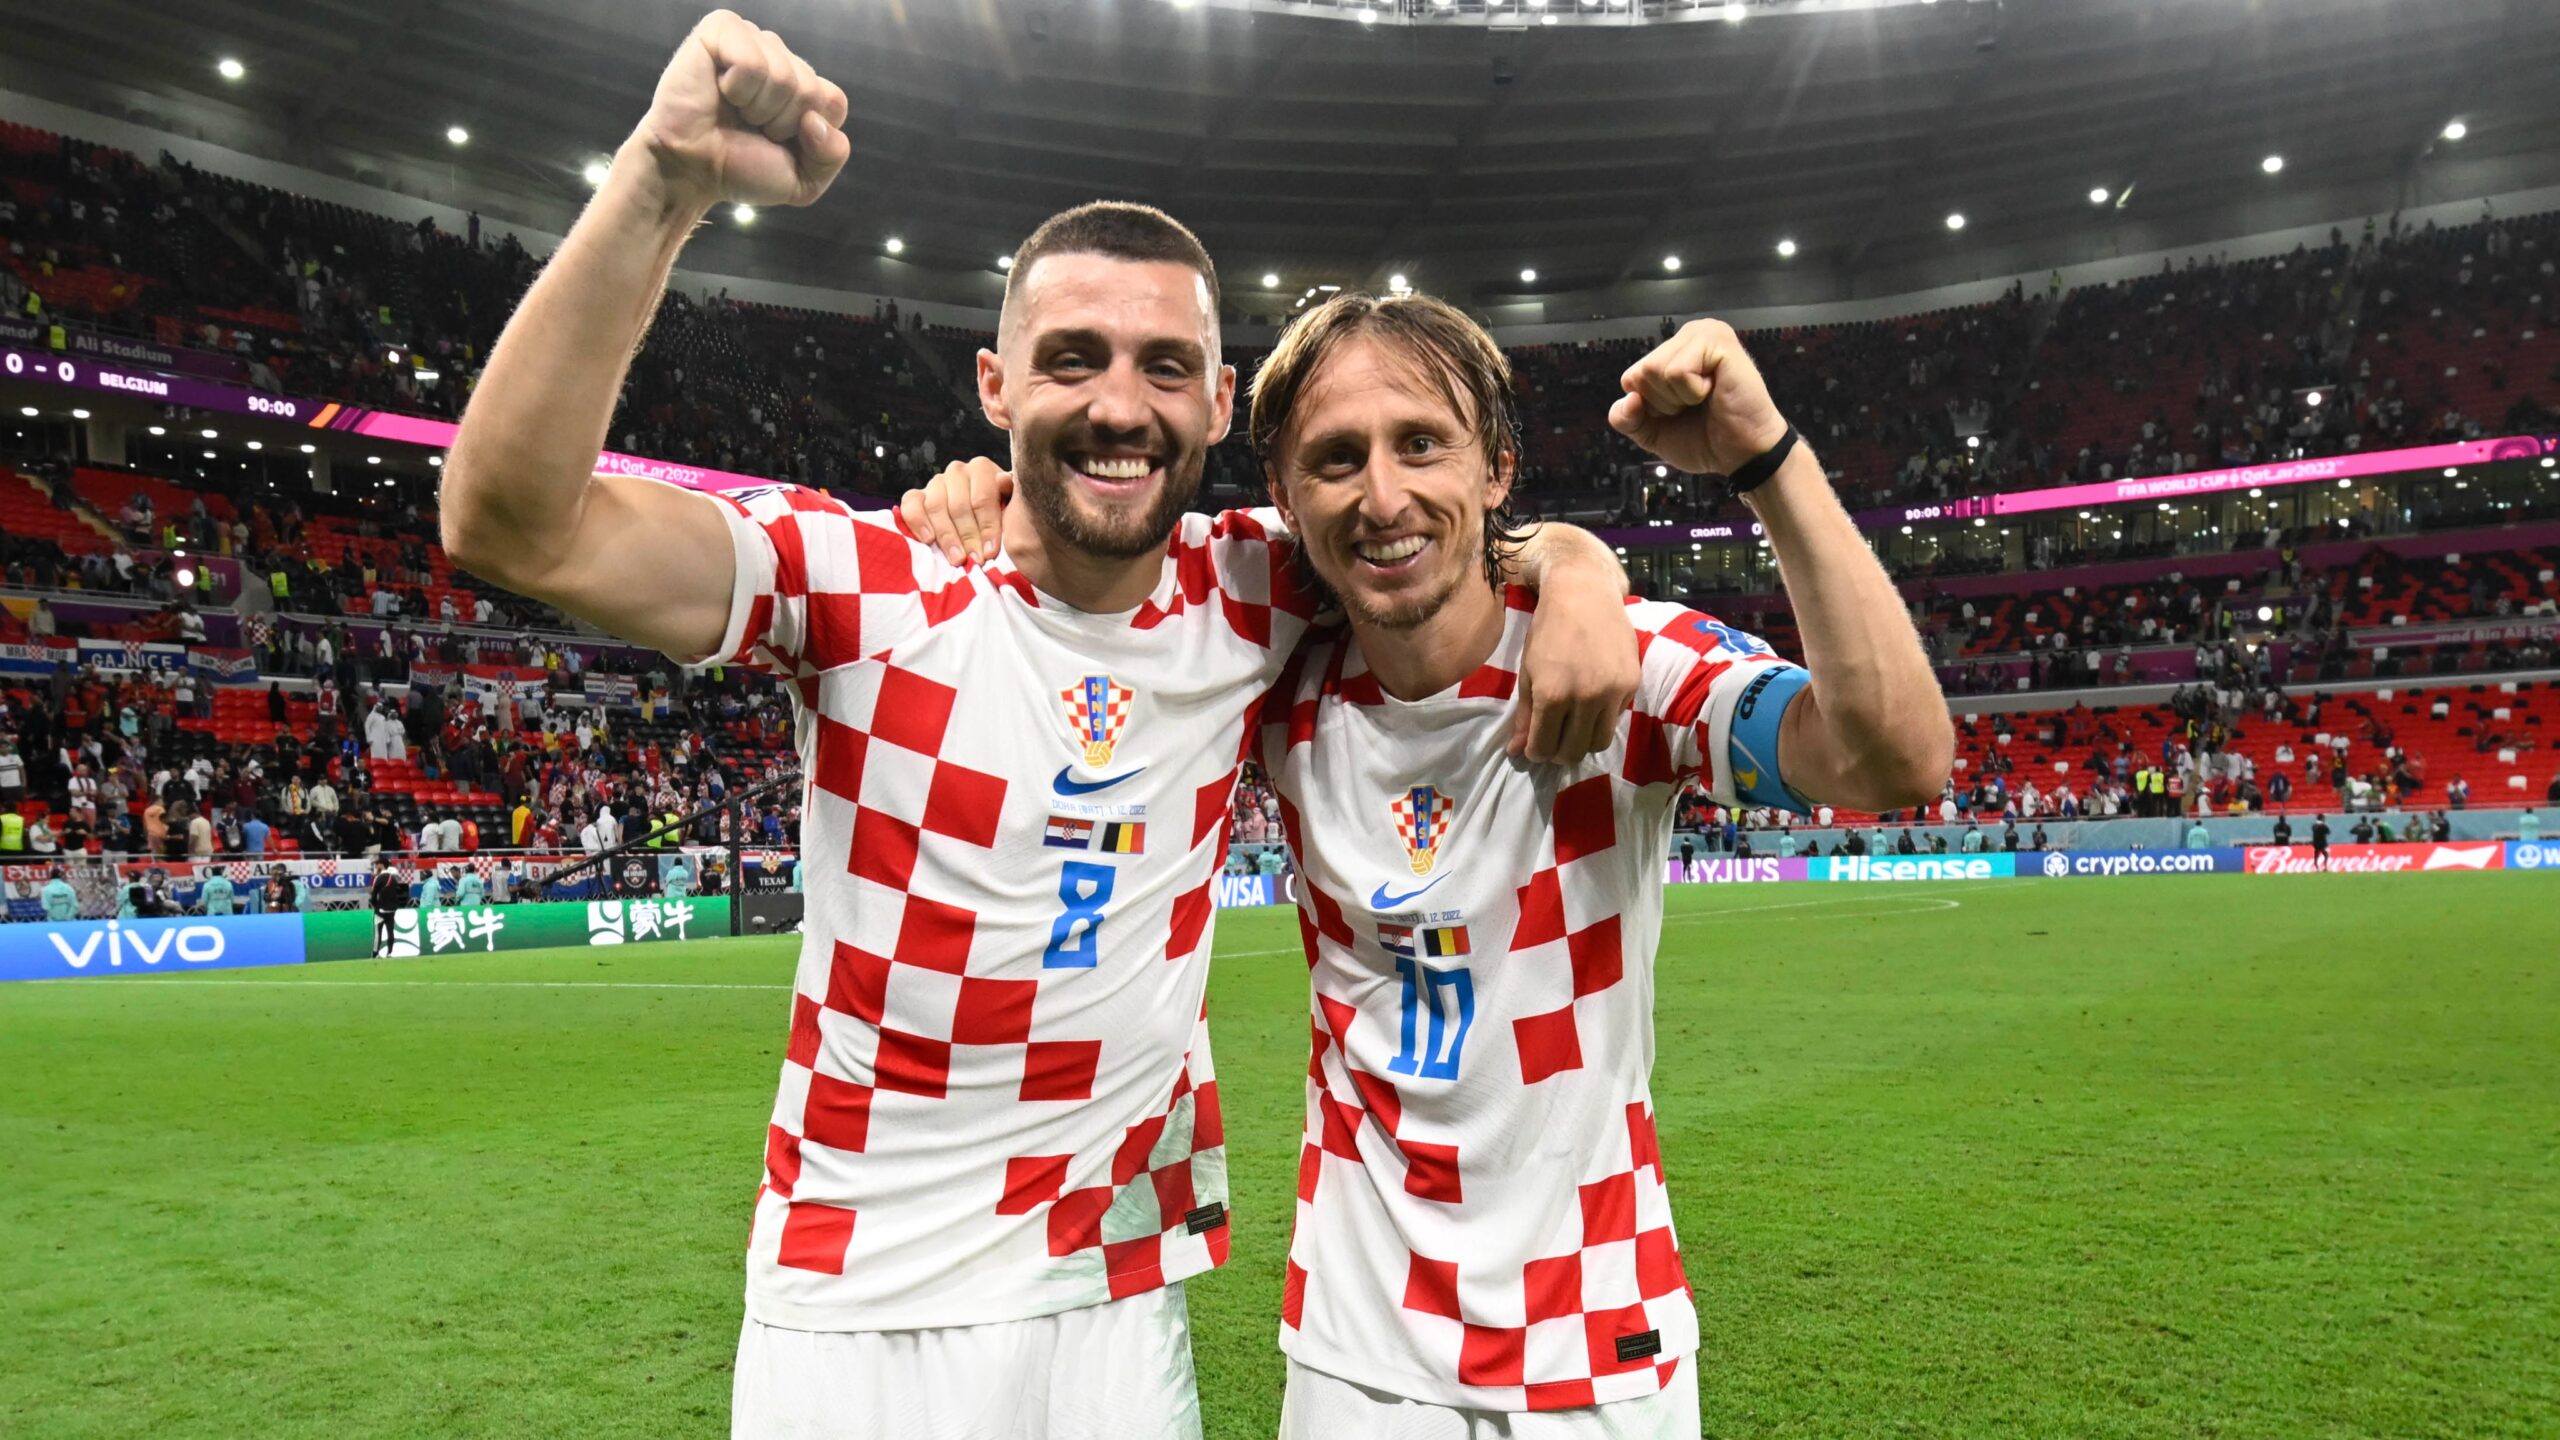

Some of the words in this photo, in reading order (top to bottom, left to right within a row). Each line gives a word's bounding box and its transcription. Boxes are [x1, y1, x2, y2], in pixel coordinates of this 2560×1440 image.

[0, 326, 38, 340] mad
[76, 336, 98, 351] Ali
[102, 340, 172, 364] Stadium
[6, 353, 23, 374] 0
[58, 362, 75, 382] 0
[100, 372, 168, 395] BELGIUM
[248, 396, 295, 417] 90:00
[2118, 481, 2148, 497] FIFA
[2148, 476, 2197, 494] WORLD
[2200, 472, 2227, 488] CUP
[1905, 506, 1940, 520] 90:00
[1690, 527, 1732, 538] CROATIA
[1752, 522, 1762, 536] 0
[91, 653, 172, 669] GAJNICE
[1091, 683, 1103, 731] HNS
[1417, 794, 1428, 839] HNS
[7, 865, 109, 880] Stugart
[1682, 857, 1779, 883] BYJU'S
[1829, 856, 1992, 881] Hisense
[2075, 853, 2213, 875] crypto.com
[759, 877, 786, 886] TEXAS
[1219, 876, 1265, 908] VISA
[426, 907, 504, 952] 蒙牛
[629, 900, 694, 941] 蒙牛
[1043, 861, 1116, 969] 8
[48, 920, 225, 969] vivo
[1387, 956, 1475, 1081] 10
